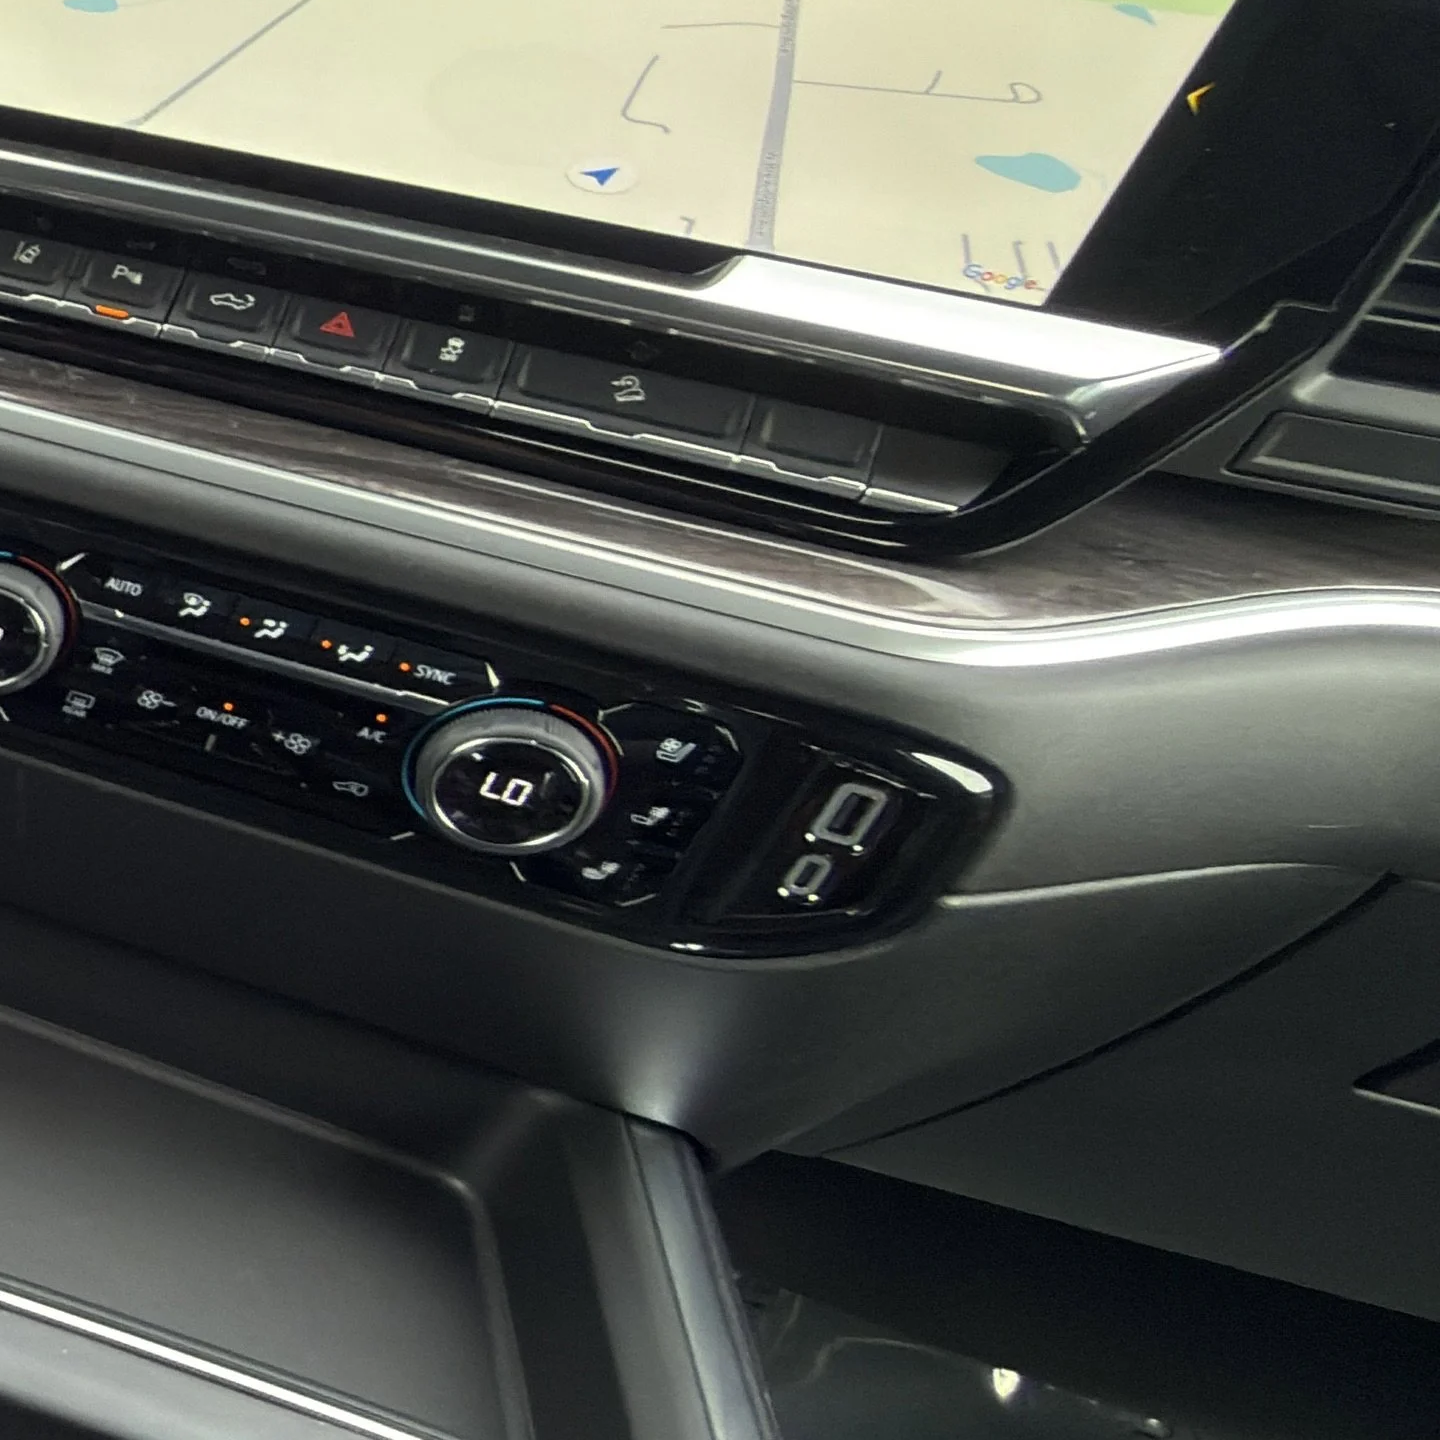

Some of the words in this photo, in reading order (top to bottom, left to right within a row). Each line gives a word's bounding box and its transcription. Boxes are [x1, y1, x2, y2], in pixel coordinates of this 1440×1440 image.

[963, 264, 1037, 291] Google
[104, 576, 143, 597] AUTO
[413, 663, 457, 686] SYNC
[195, 705, 250, 730] ON/OFF
[355, 725, 387, 744] A/C
